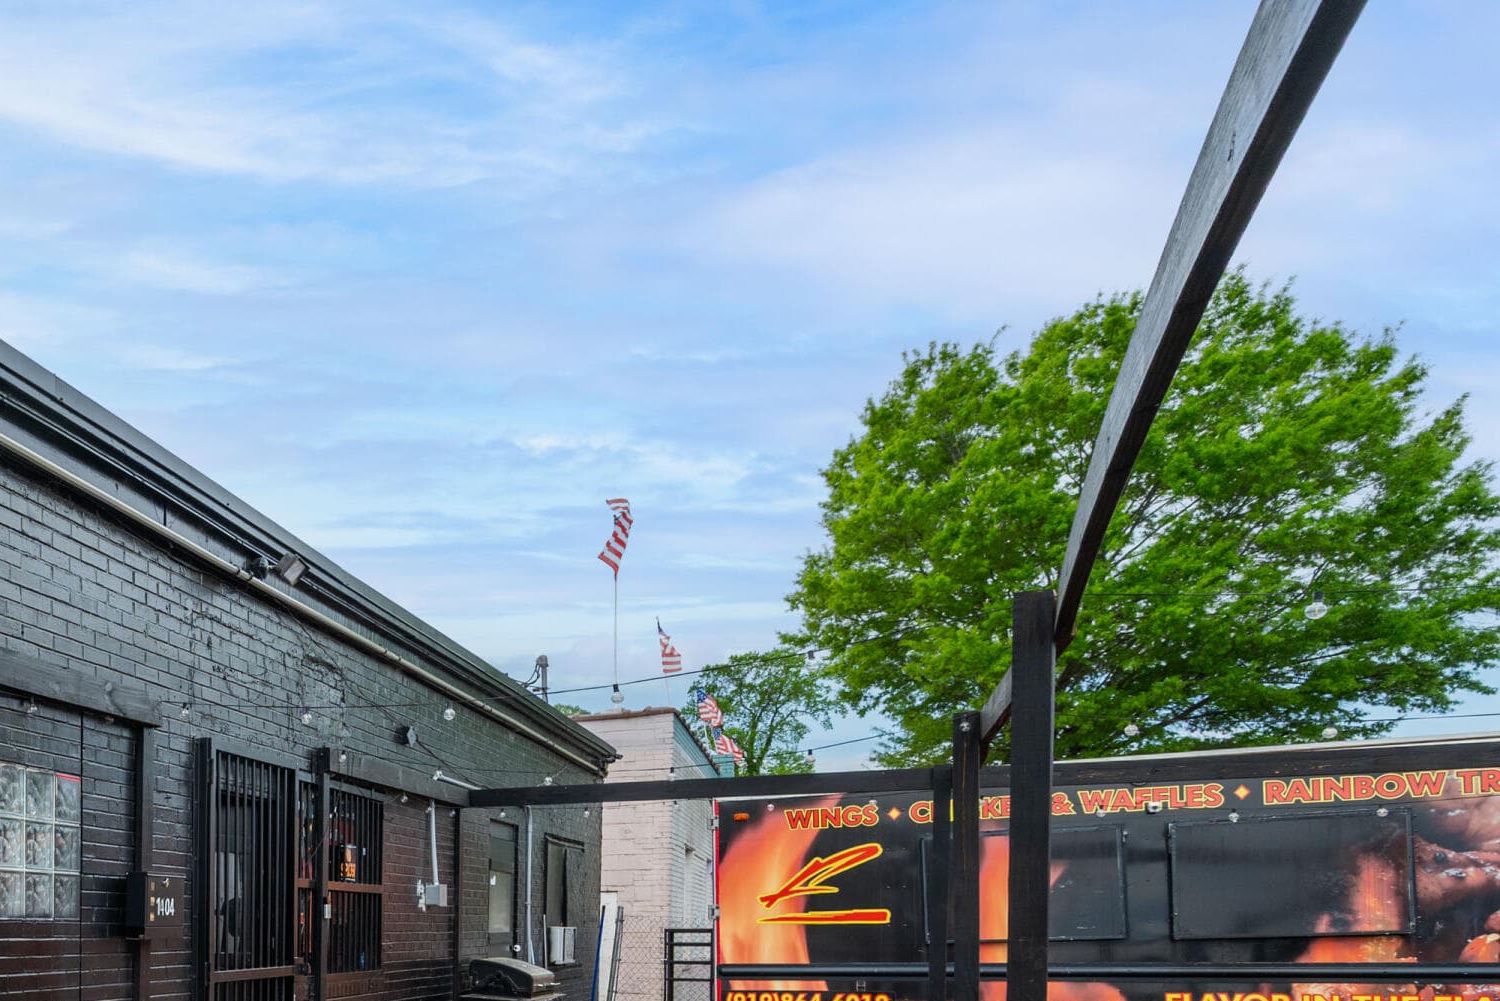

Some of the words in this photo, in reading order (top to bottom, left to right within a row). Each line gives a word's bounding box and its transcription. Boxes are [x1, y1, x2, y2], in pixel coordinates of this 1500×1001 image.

[785, 804, 879, 830] WINGS
[1051, 792, 1077, 816] &
[1077, 782, 1225, 815] WAFFLES
[1262, 770, 1447, 805] RAINBOW
[156, 897, 175, 916] 1404
